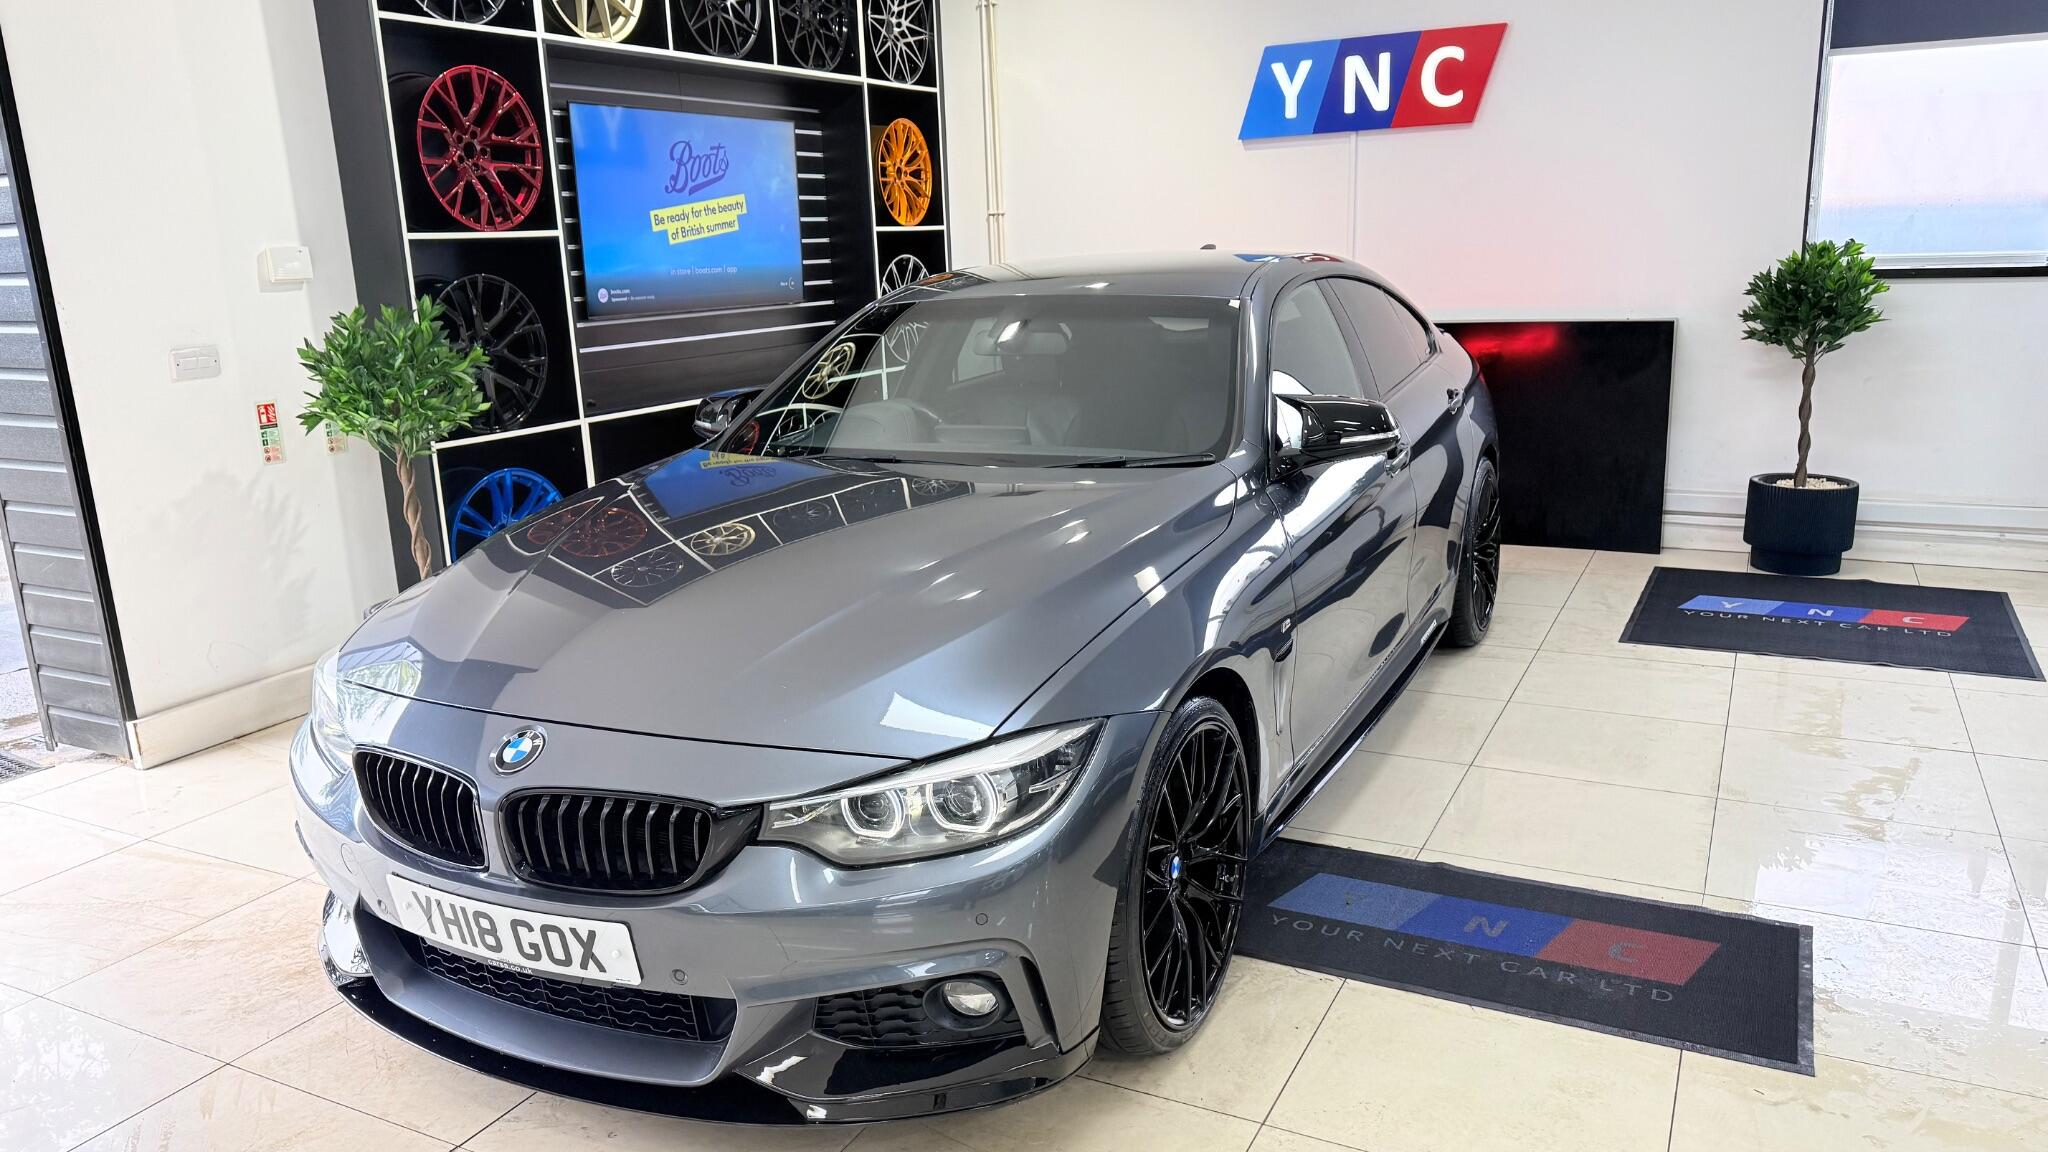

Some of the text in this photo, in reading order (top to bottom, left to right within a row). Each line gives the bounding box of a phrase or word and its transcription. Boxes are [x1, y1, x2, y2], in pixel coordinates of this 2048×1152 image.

[1271, 45, 1465, 119] YNC
[664, 139, 729, 196] Boots
[653, 200, 744, 226] Be ready for the beauty
[671, 219, 737, 241] of British summer
[695, 266, 723, 275] boots.com
[726, 266, 738, 275] app
[1683, 609, 1952, 638] YOUR NEXT CAR LTD
[1719, 600, 1924, 625] YNC
[411, 890, 608, 974] YH18 GOX
[1269, 914, 1677, 1003] YOUR NEXT CAR LTD
